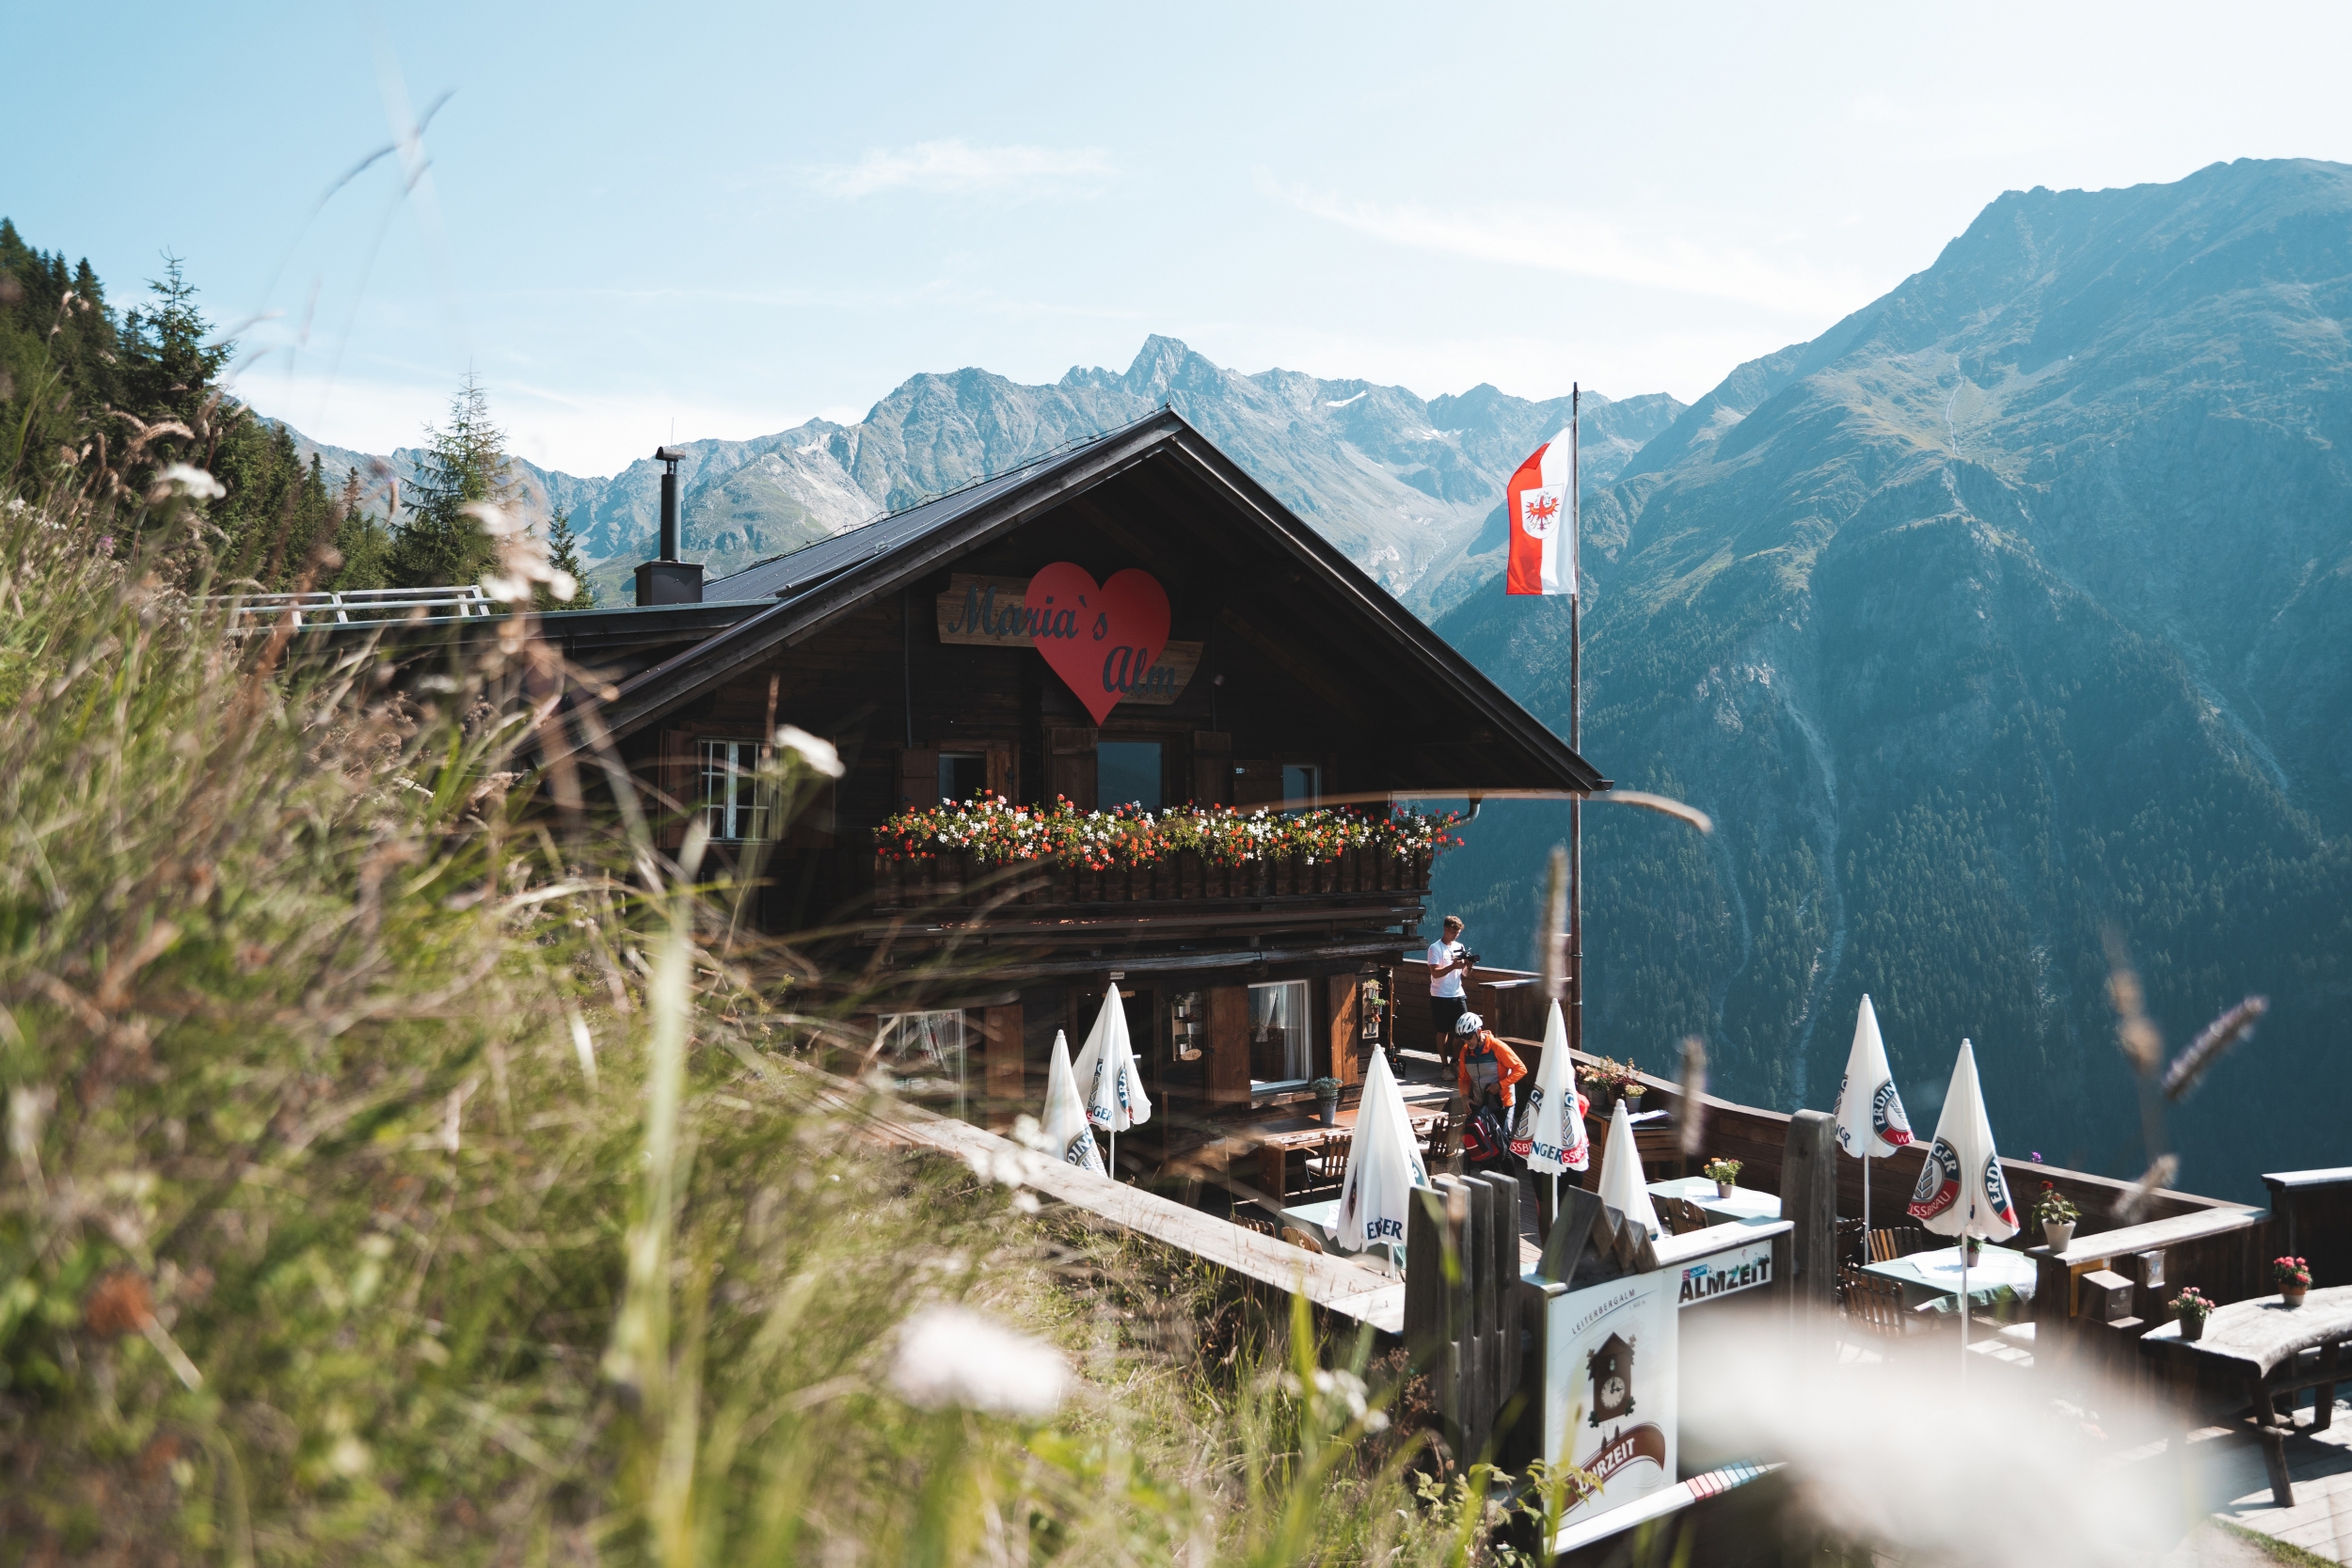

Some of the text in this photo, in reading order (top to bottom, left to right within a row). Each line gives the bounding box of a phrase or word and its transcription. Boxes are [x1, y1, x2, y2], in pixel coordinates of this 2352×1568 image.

[1103, 645, 1176, 695] Alm
[1677, 1256, 1771, 1305] ALMZEIT
[1572, 1289, 1636, 1335] LEITERBERGALM
